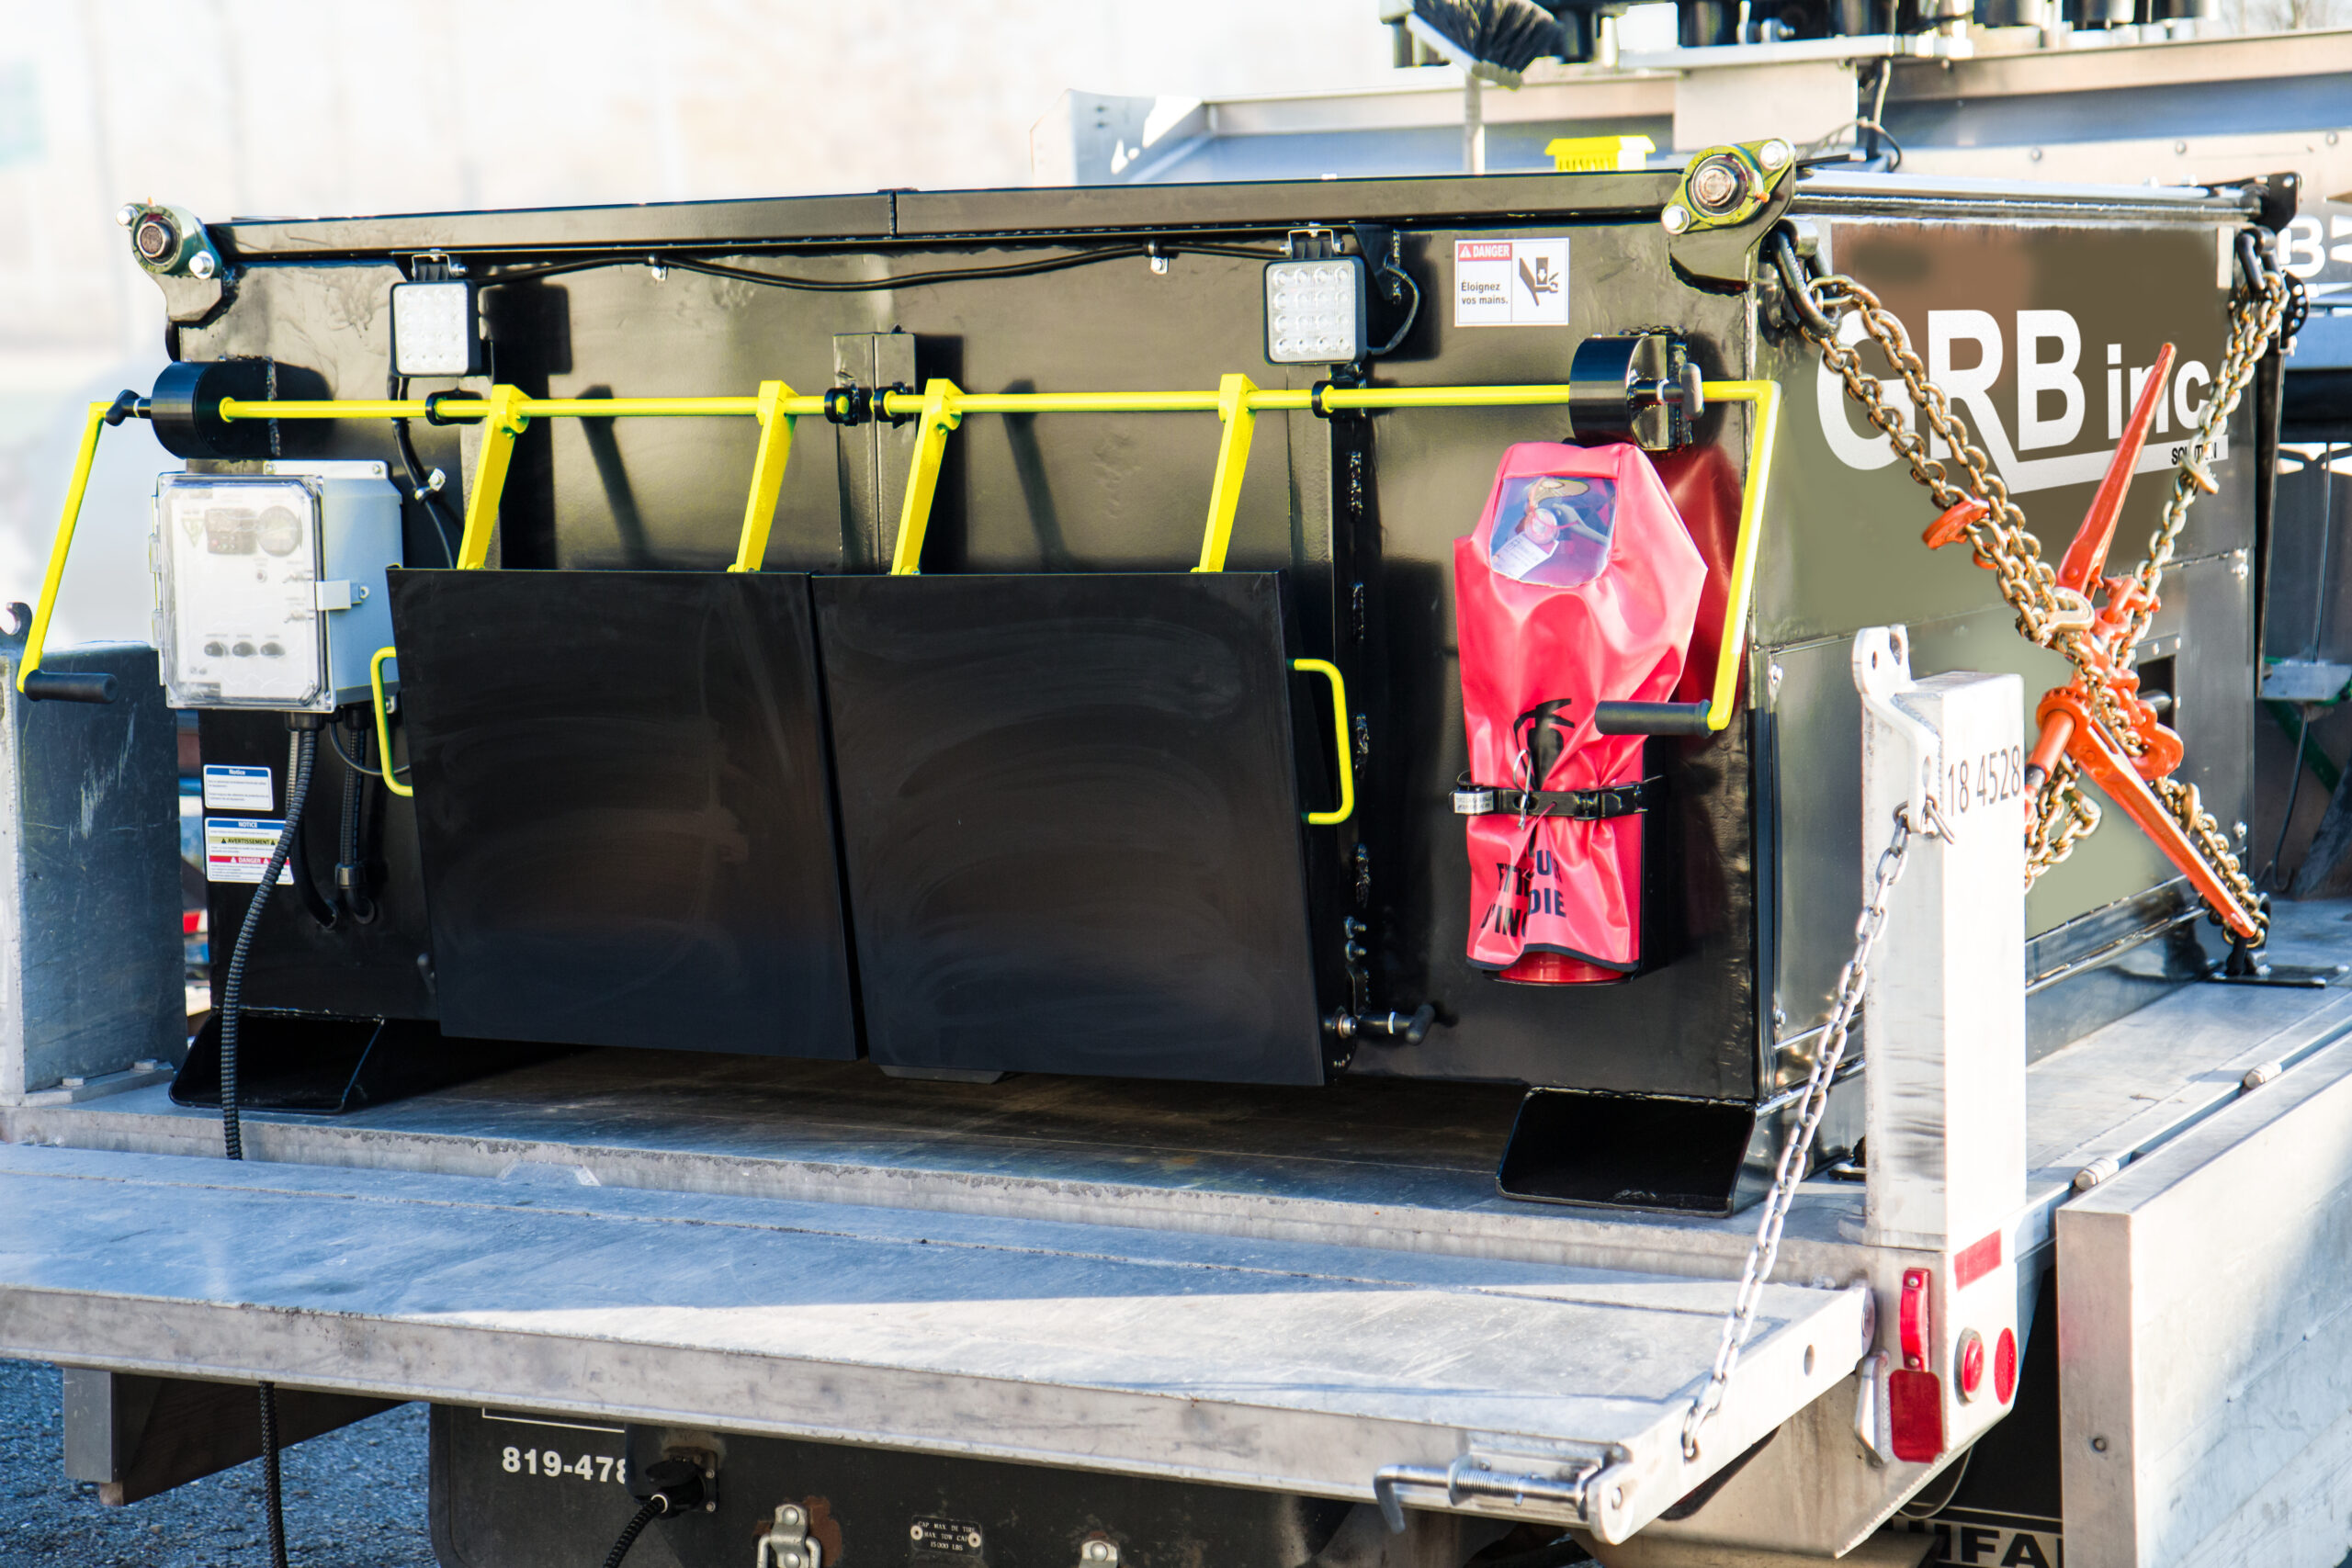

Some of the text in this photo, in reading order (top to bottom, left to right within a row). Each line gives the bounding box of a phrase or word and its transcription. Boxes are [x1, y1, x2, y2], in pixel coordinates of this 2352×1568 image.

[1473, 244, 1510, 258] DANGER
[1461, 279, 1500, 293] Éloignez
[1462, 295, 1509, 305] vos mains.
[1816, 310, 2086, 470] GRB
[1948, 745, 2020, 817] 18 4528
[228, 838, 269, 846] AVERTISSEMENT
